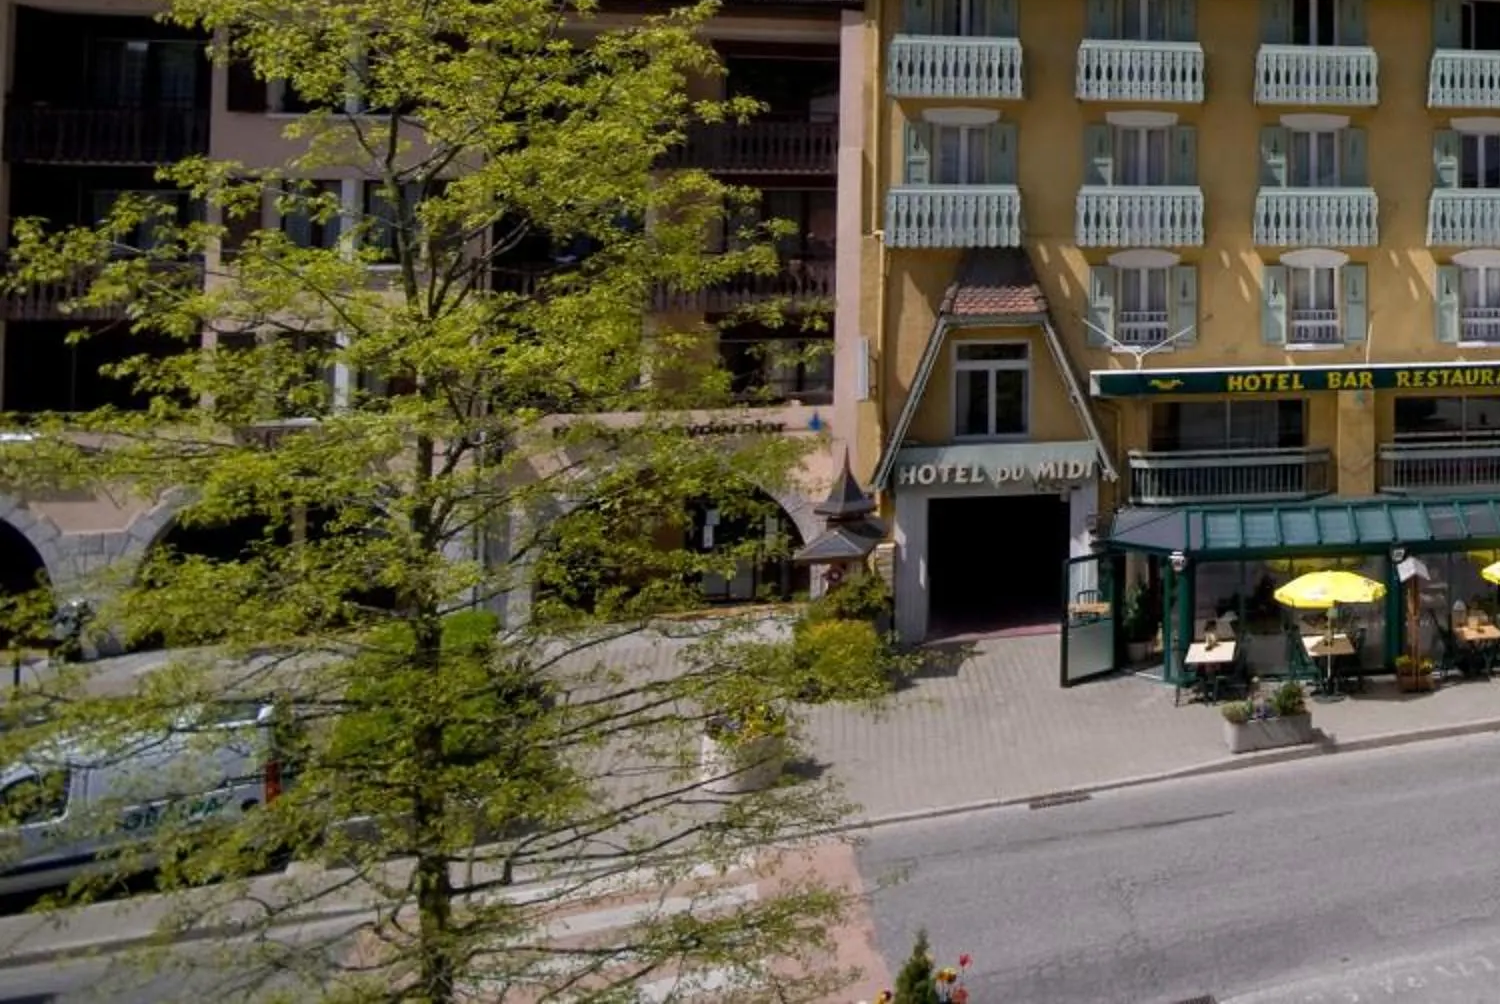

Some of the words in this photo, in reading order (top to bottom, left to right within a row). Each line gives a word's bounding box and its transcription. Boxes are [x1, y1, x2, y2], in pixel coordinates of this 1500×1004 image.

[1227, 373, 1305, 392] HOTEL
[1327, 371, 1373, 389] BAR
[899, 463, 984, 485] HOTEL
[1038, 459, 1093, 481] MIDI
